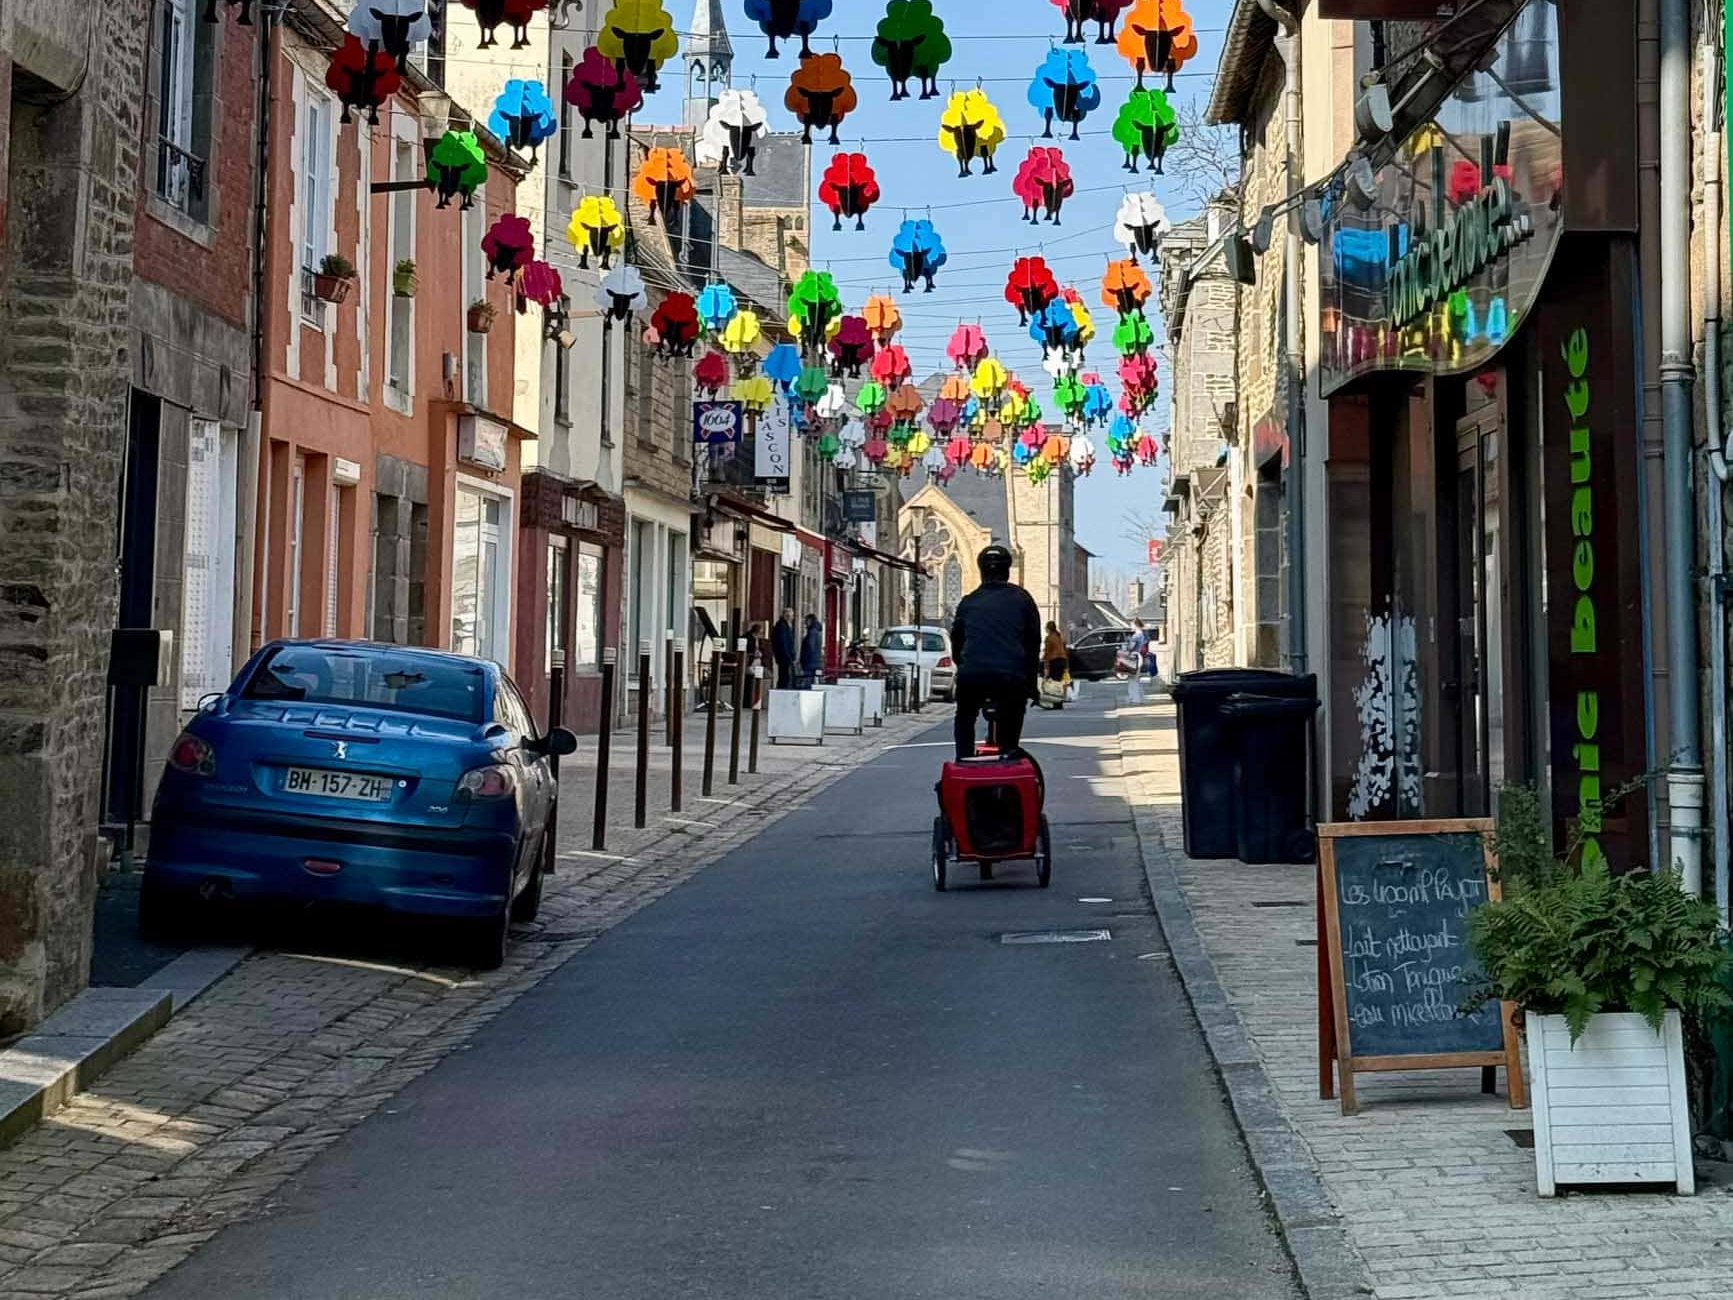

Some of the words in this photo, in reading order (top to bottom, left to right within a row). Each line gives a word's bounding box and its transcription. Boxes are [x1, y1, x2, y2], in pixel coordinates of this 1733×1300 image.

[760, 411, 784, 474] GASCON
[1560, 326, 1597, 653] beauté
[1572, 691, 1602, 882] onic
[1341, 874, 1370, 905] Les
